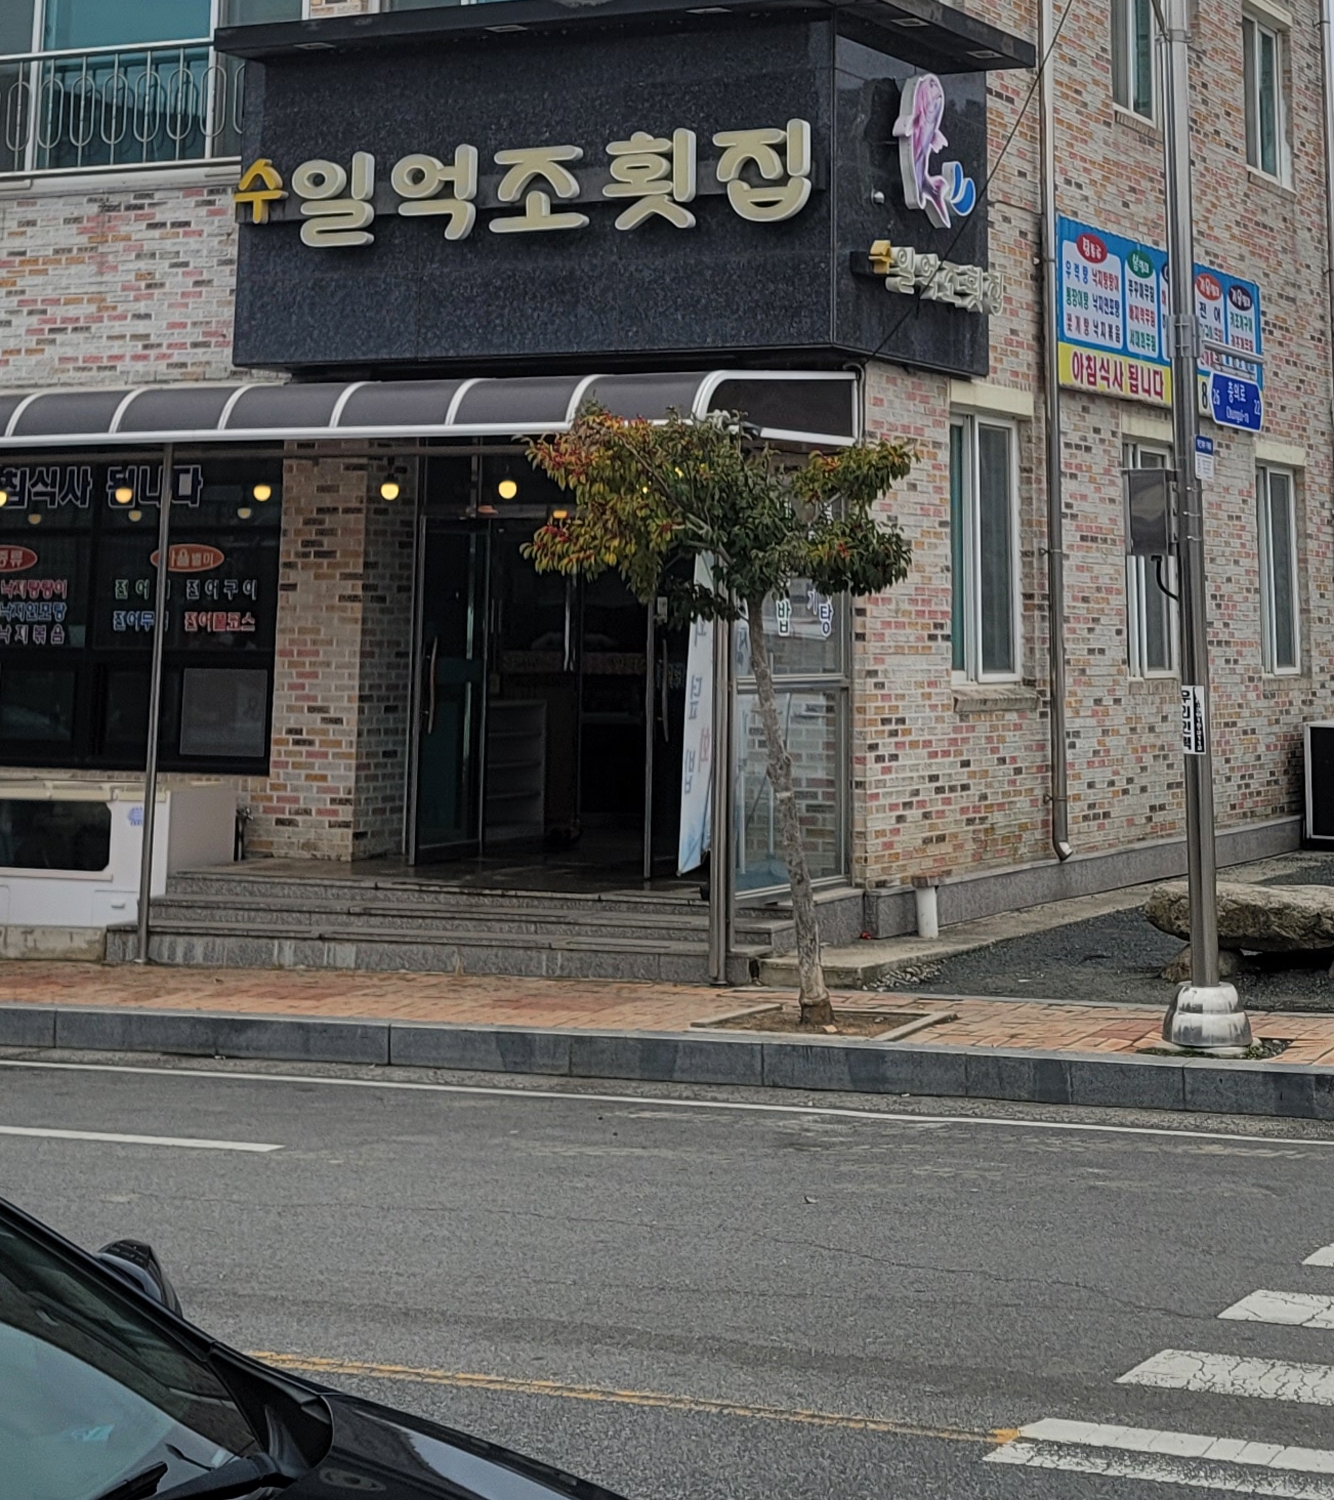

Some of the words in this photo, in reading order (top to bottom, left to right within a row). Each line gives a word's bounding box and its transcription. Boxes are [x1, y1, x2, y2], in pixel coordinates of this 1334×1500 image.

[1071, 352, 1124, 392] 아침식사
[1127, 363, 1165, 400] 됩니다
[1254, 399, 1261, 416] 22
[113, 610, 169, 632] 전어무
